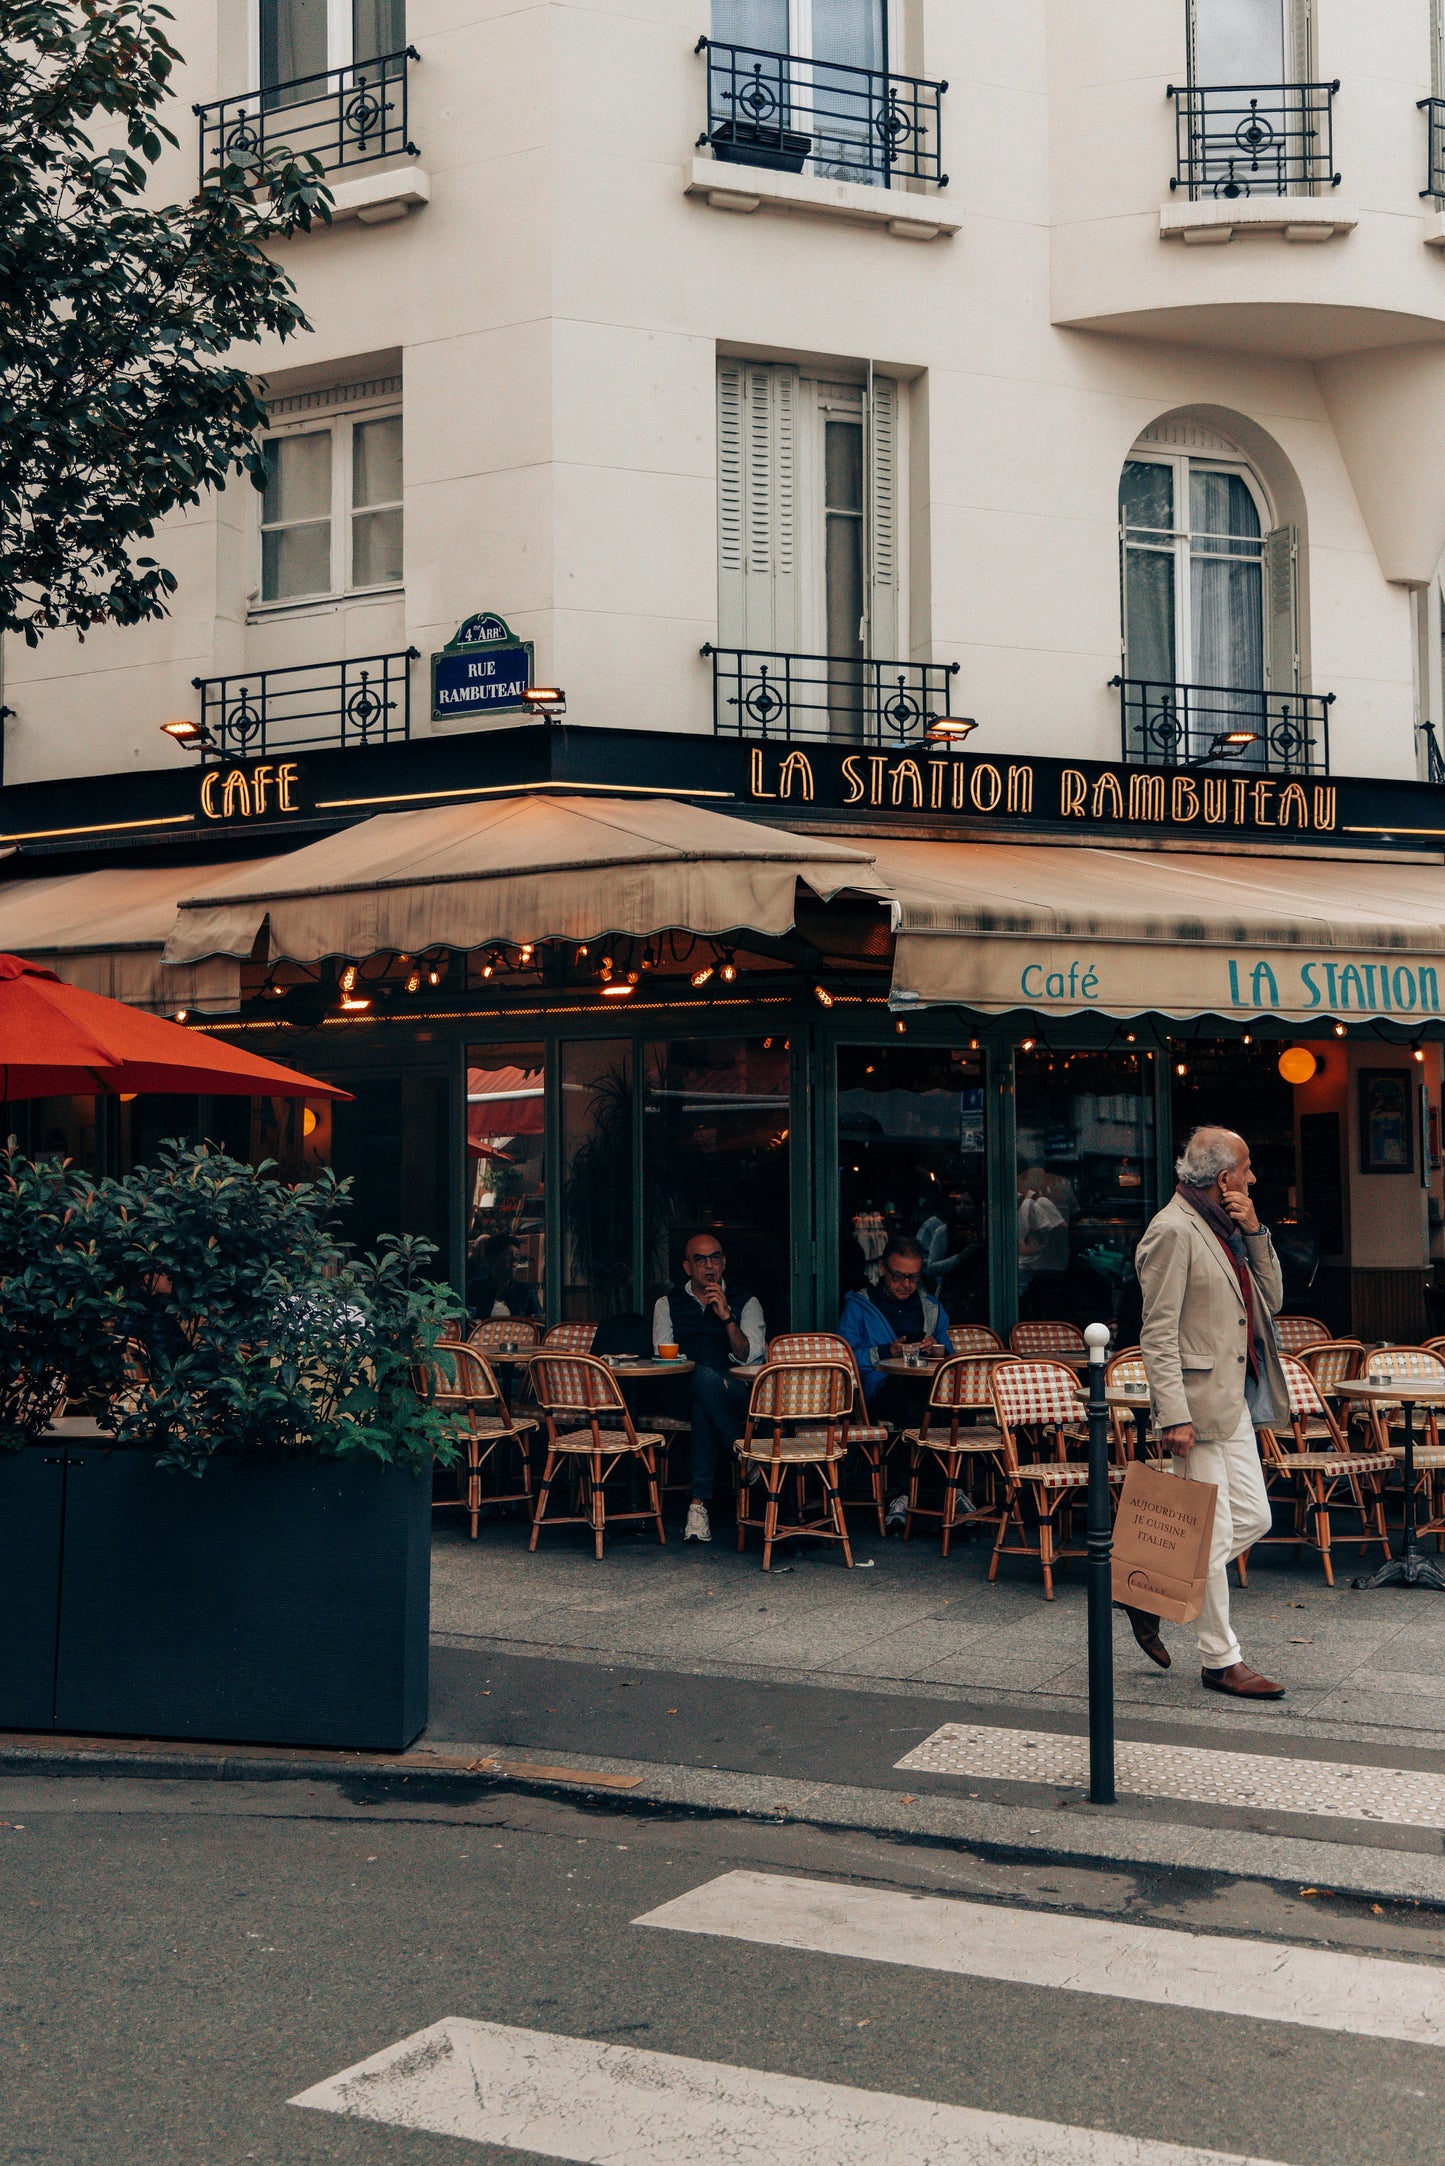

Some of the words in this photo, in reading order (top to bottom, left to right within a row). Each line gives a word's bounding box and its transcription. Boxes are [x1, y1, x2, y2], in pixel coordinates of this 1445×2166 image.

[468, 661, 496, 678] RUE
[439, 680, 526, 705] RAMBUTEAU
[200, 762, 300, 819] CAFE
[751, 747, 814, 801] LA
[841, 755, 1034, 813] STATION
[1060, 769, 1337, 831] RAMBUTEAU
[1020, 961, 1099, 1000] Café
[1228, 959, 1281, 1008] LA
[1301, 962, 1441, 1012] STATION
[1129, 1497, 1197, 1526] AUJOURD'HUI
[1132, 1514, 1145, 1525] JE
[1146, 1518, 1187, 1538] CUISINE
[1137, 1530, 1177, 1551] ITALIEN
